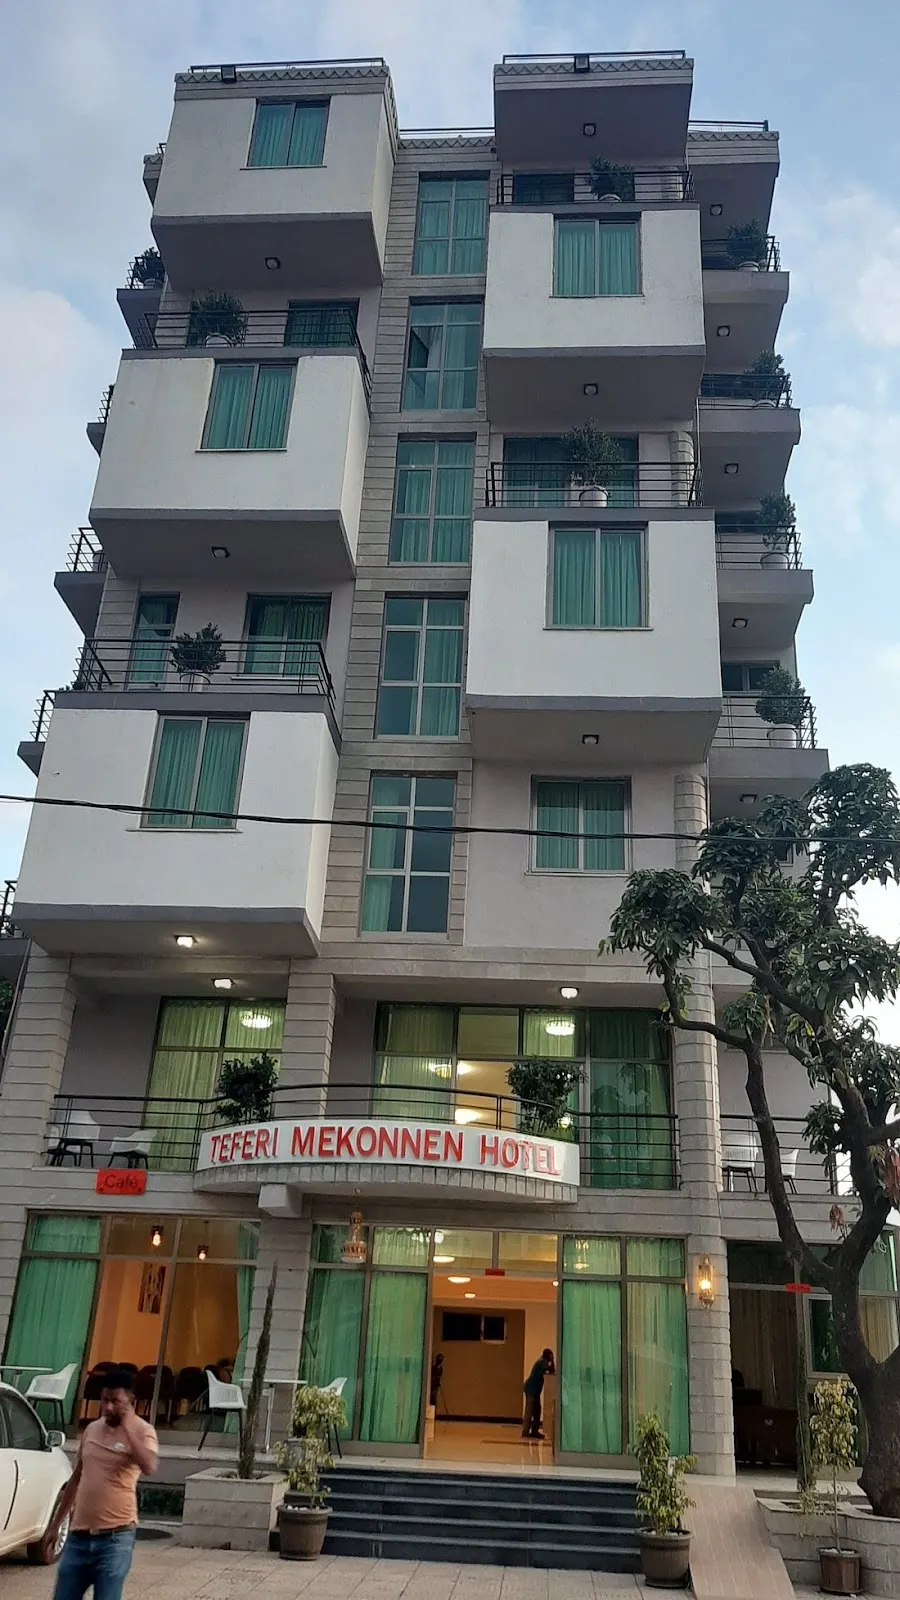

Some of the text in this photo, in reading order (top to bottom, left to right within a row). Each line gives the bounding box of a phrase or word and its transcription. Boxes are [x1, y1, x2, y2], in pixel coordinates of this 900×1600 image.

[211, 1126, 561, 1176] TEFERI MEKONNEN HOTEL
